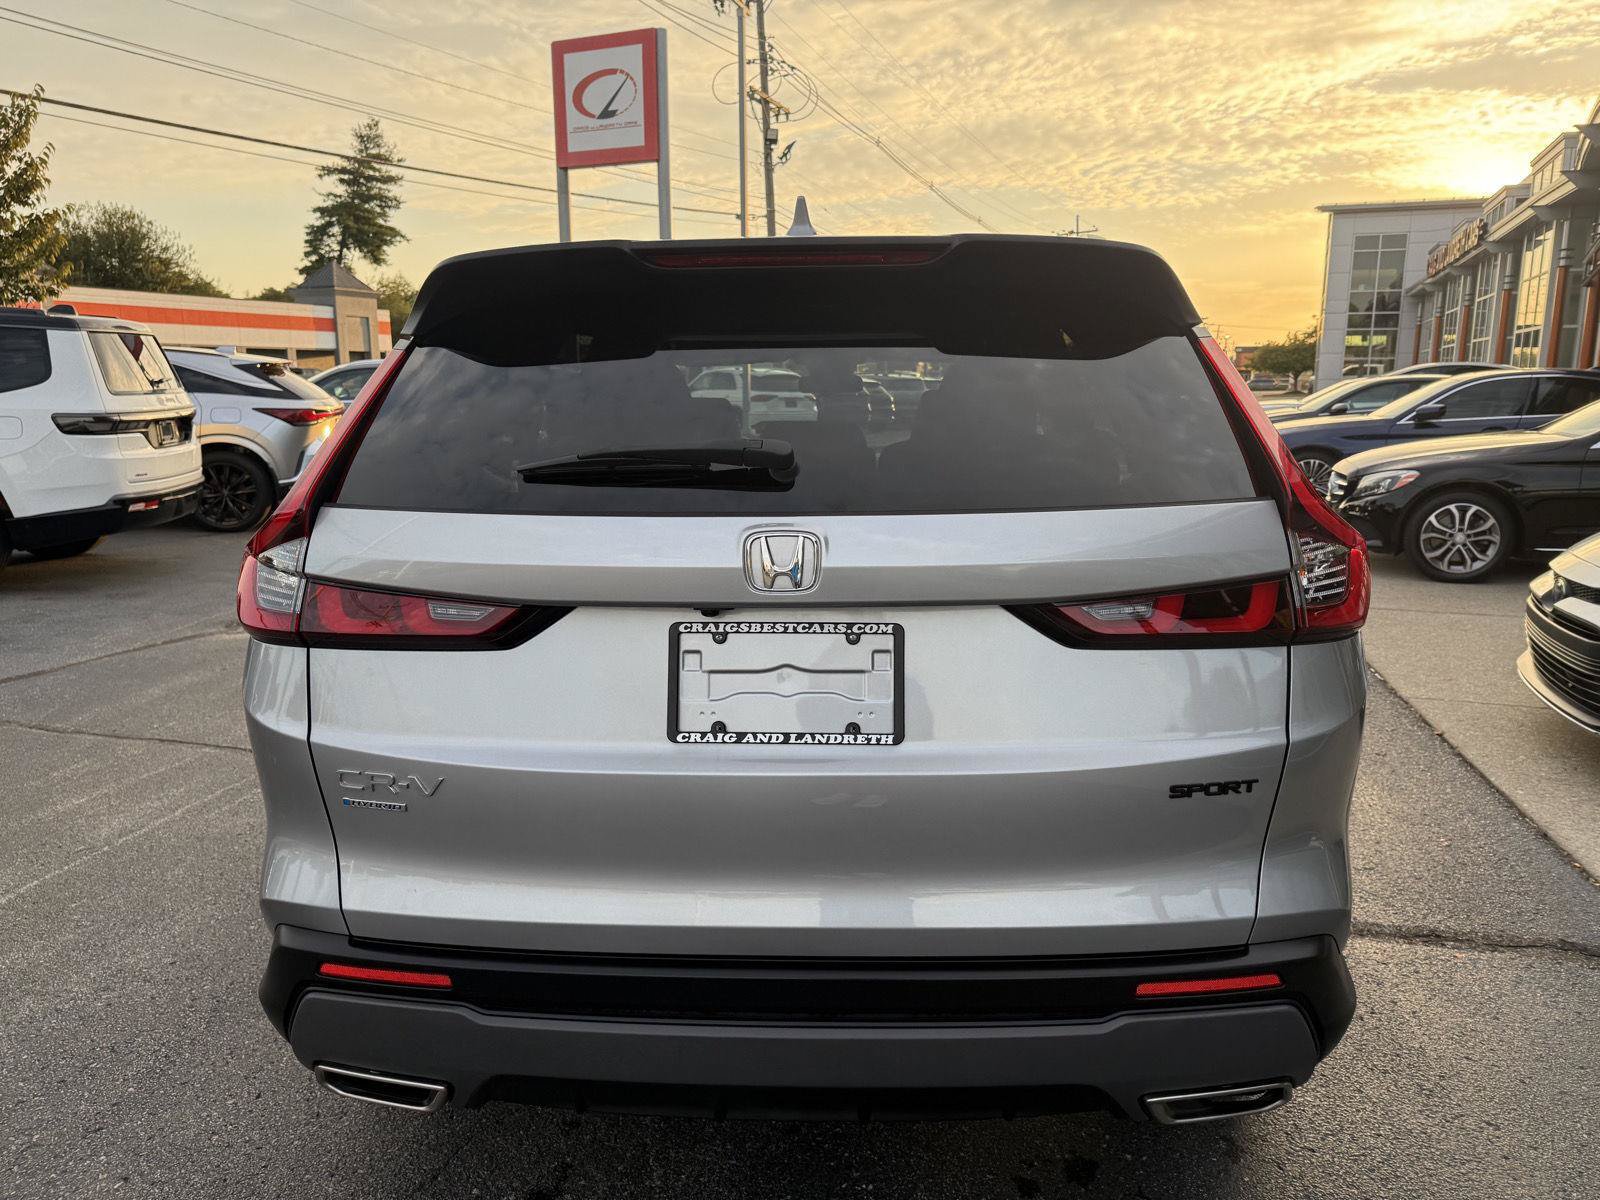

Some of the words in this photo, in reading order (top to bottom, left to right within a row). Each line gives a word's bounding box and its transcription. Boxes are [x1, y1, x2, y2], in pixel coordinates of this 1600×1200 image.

[678, 623, 894, 634] CRAIGSBESTCARS.COM
[676, 733, 738, 743] CRAIG
[741, 733, 784, 744] AND
[789, 734, 895, 744] LANDRETH
[336, 769, 445, 798] CR-V
[1168, 779, 1260, 799] SPORT
[350, 799, 403, 811] HYBRID
